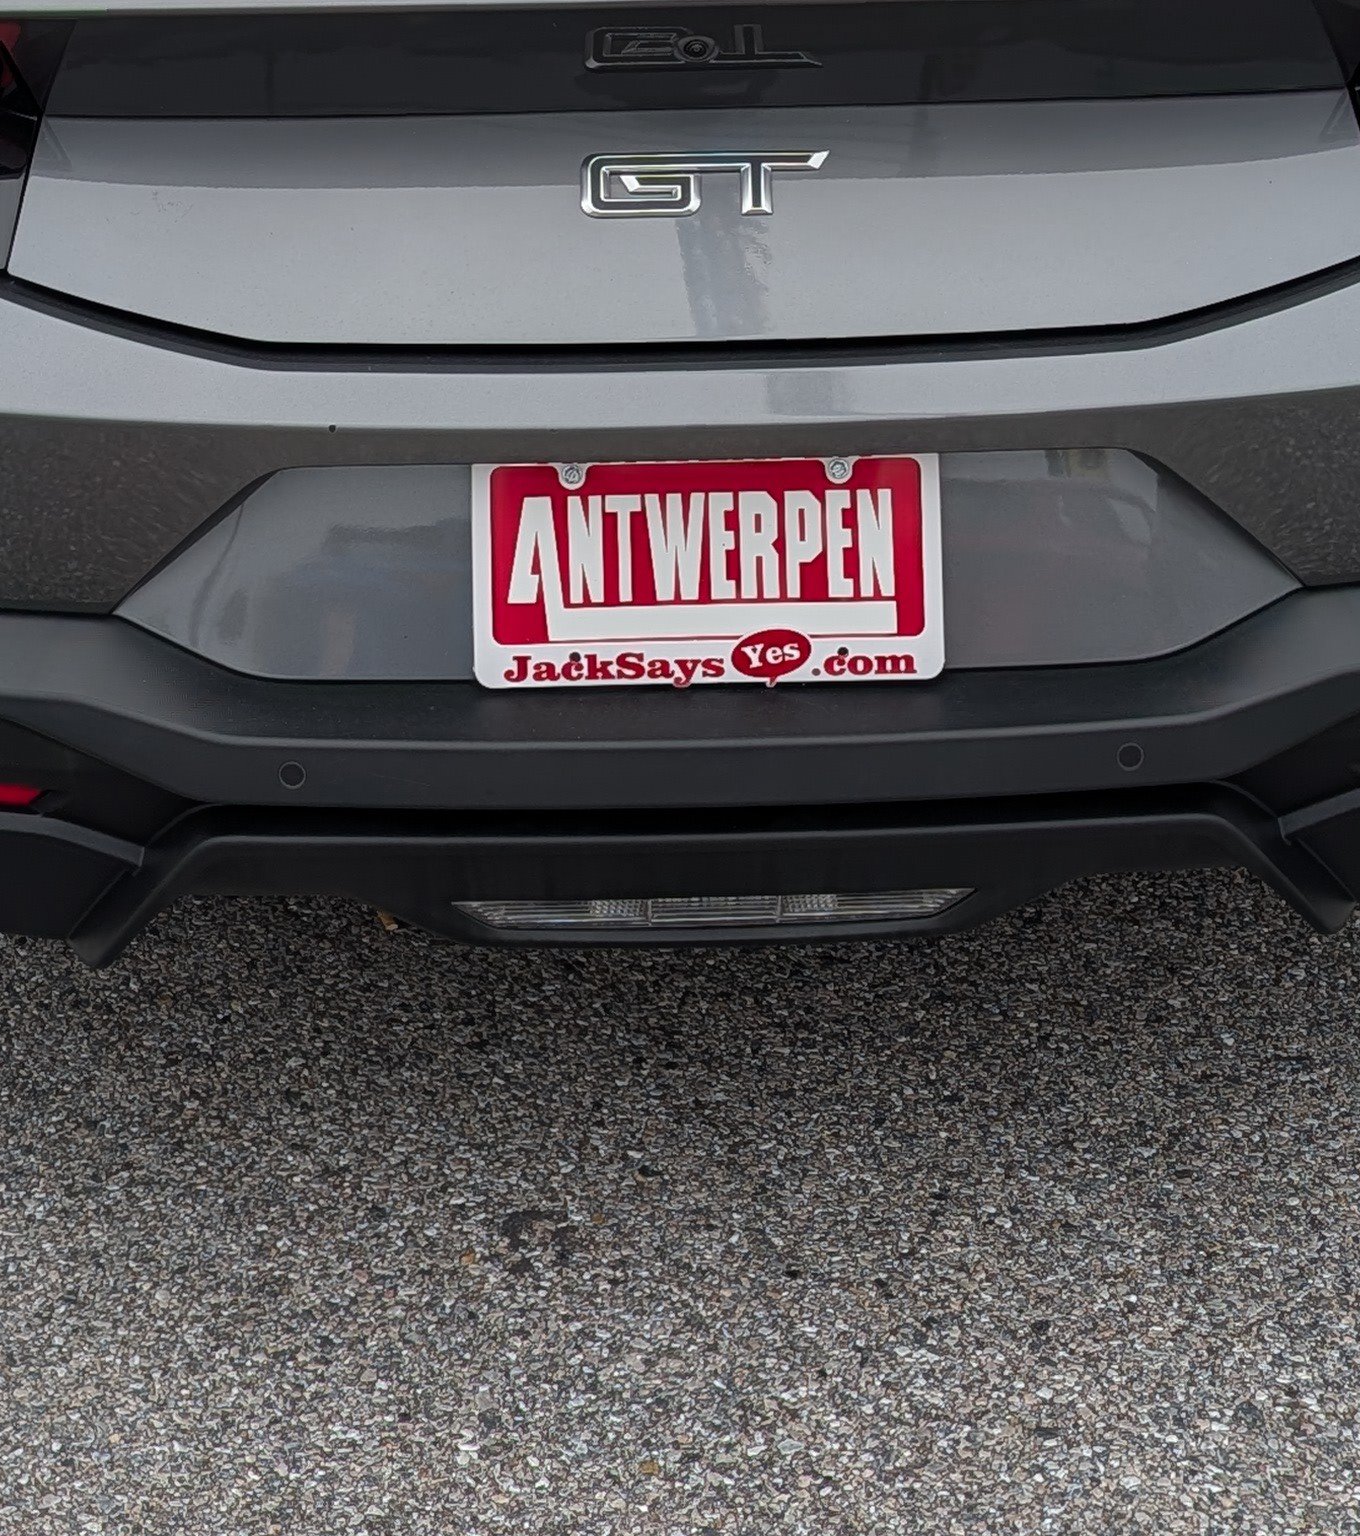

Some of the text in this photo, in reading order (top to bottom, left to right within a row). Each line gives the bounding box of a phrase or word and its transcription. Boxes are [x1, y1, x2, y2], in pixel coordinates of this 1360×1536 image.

[580, 149, 830, 218] GT
[507, 488, 899, 640] ANTWERPEN
[504, 651, 725, 688] JackSays
[740, 641, 802, 670] Yes
